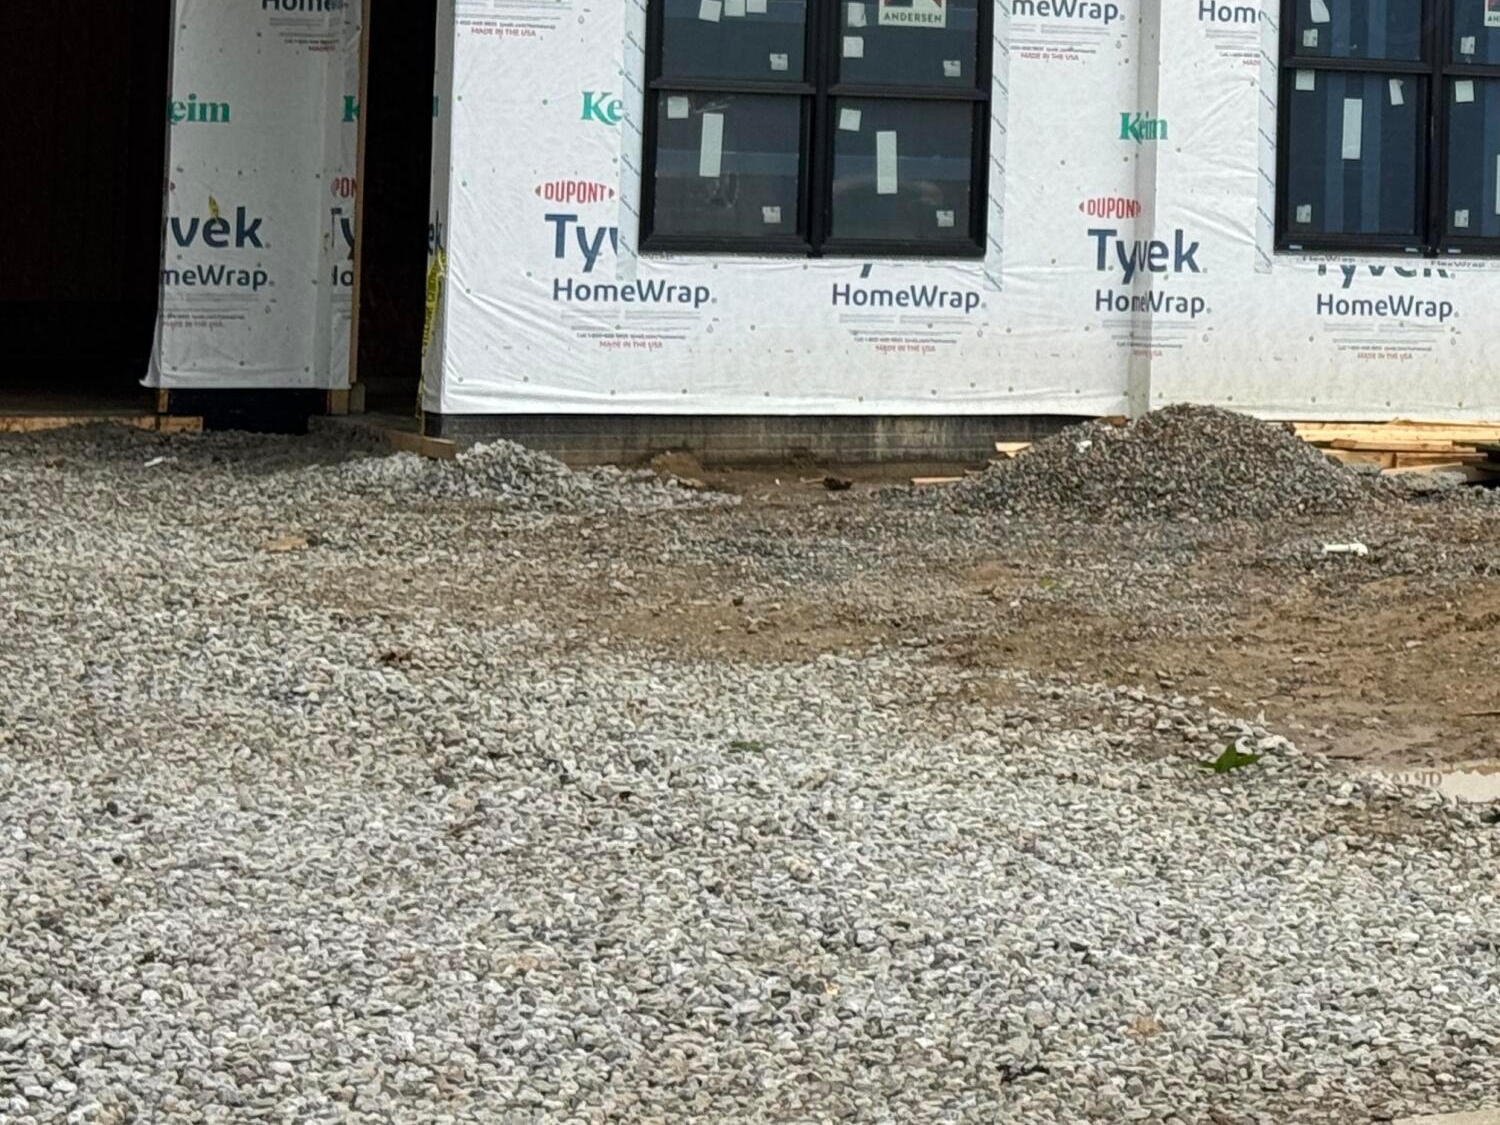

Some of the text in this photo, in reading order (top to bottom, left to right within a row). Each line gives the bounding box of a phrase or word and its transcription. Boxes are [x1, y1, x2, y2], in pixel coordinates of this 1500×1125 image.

[883, 11, 943, 24] ANDERSEN
[169, 93, 230, 124] eim
[581, 91, 623, 126] Ke
[544, 180, 607, 204] DUPONT
[167, 206, 263, 248] vek
[163, 265, 268, 291] meWrap
[553, 278, 711, 309] HomeWrap
[831, 283, 981, 314] HomeWrap
[1316, 293, 1454, 322] HomeWrap
